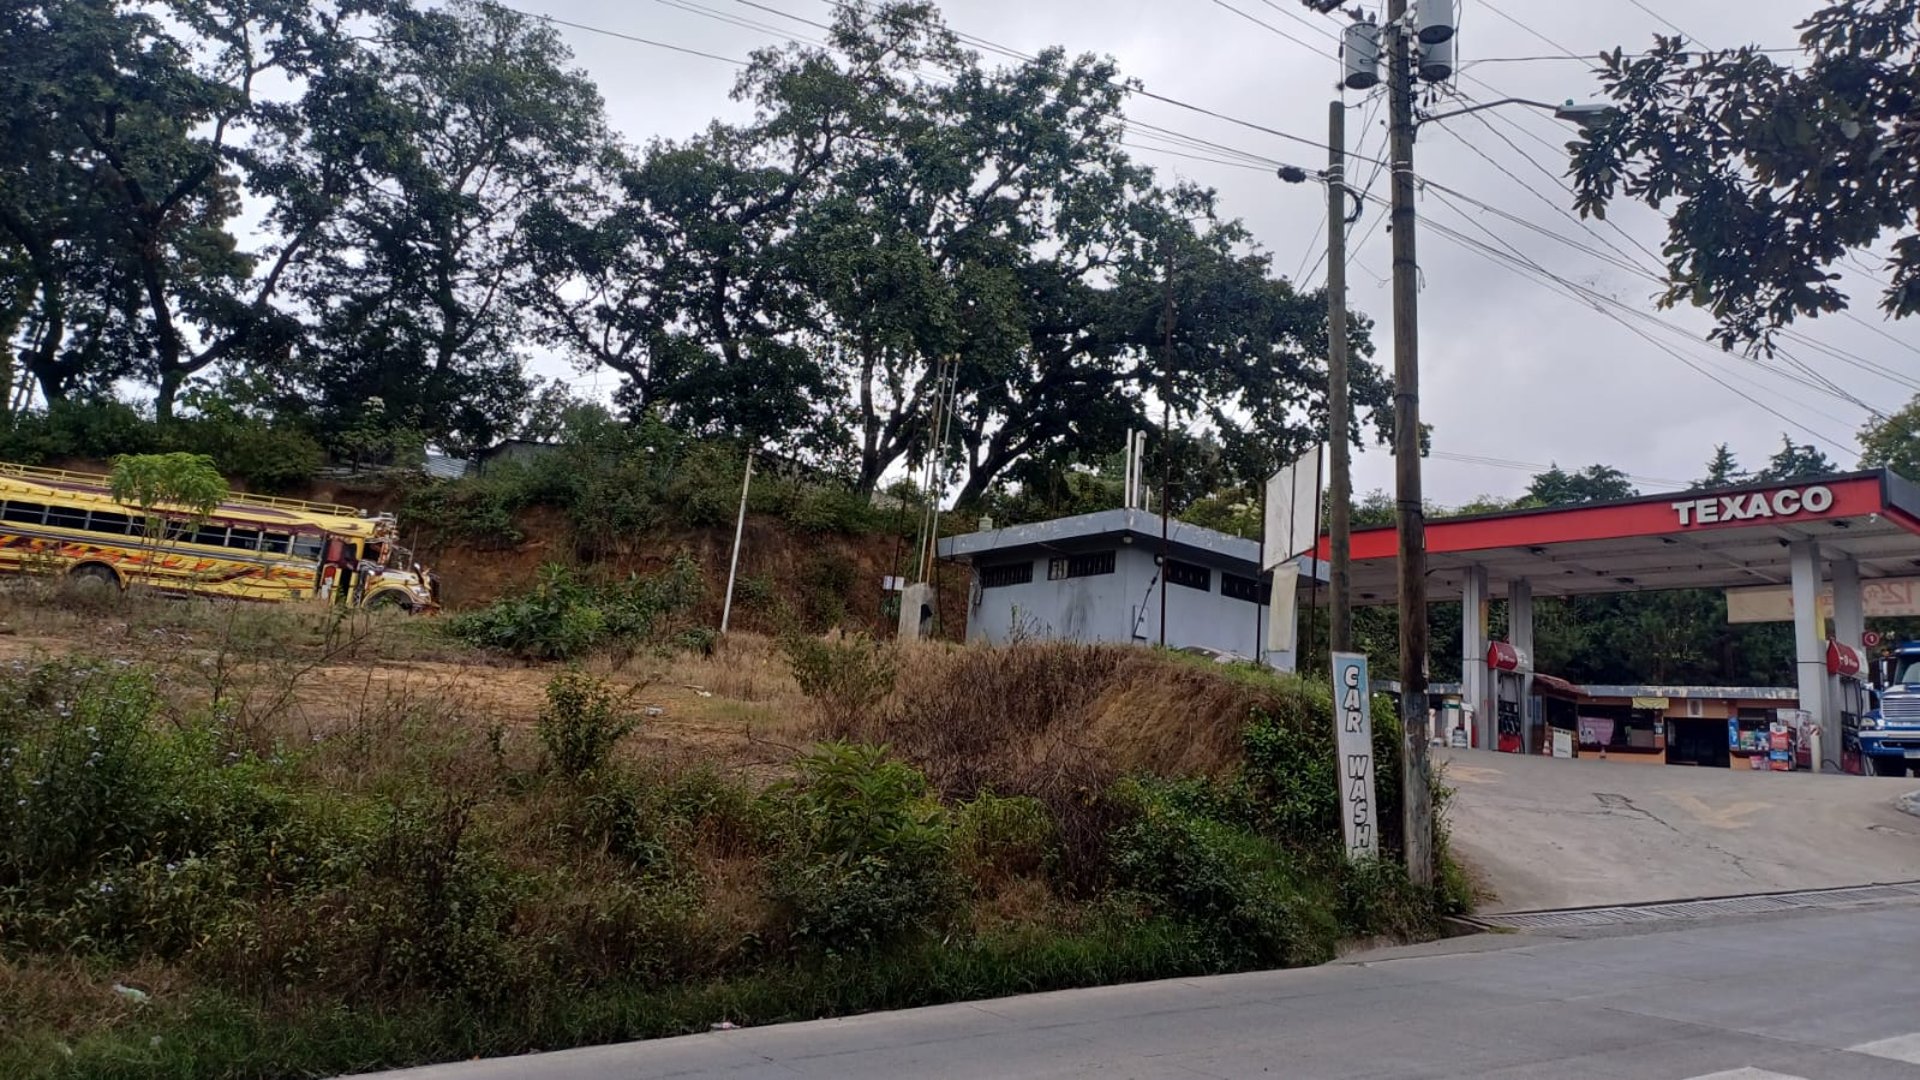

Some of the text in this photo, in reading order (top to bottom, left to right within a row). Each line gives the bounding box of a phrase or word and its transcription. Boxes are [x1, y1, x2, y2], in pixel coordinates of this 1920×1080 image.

[1672, 486, 1833, 525] TEXACO
[1343, 665, 1362, 733] CAR
[1348, 755, 1370, 848] WASH
